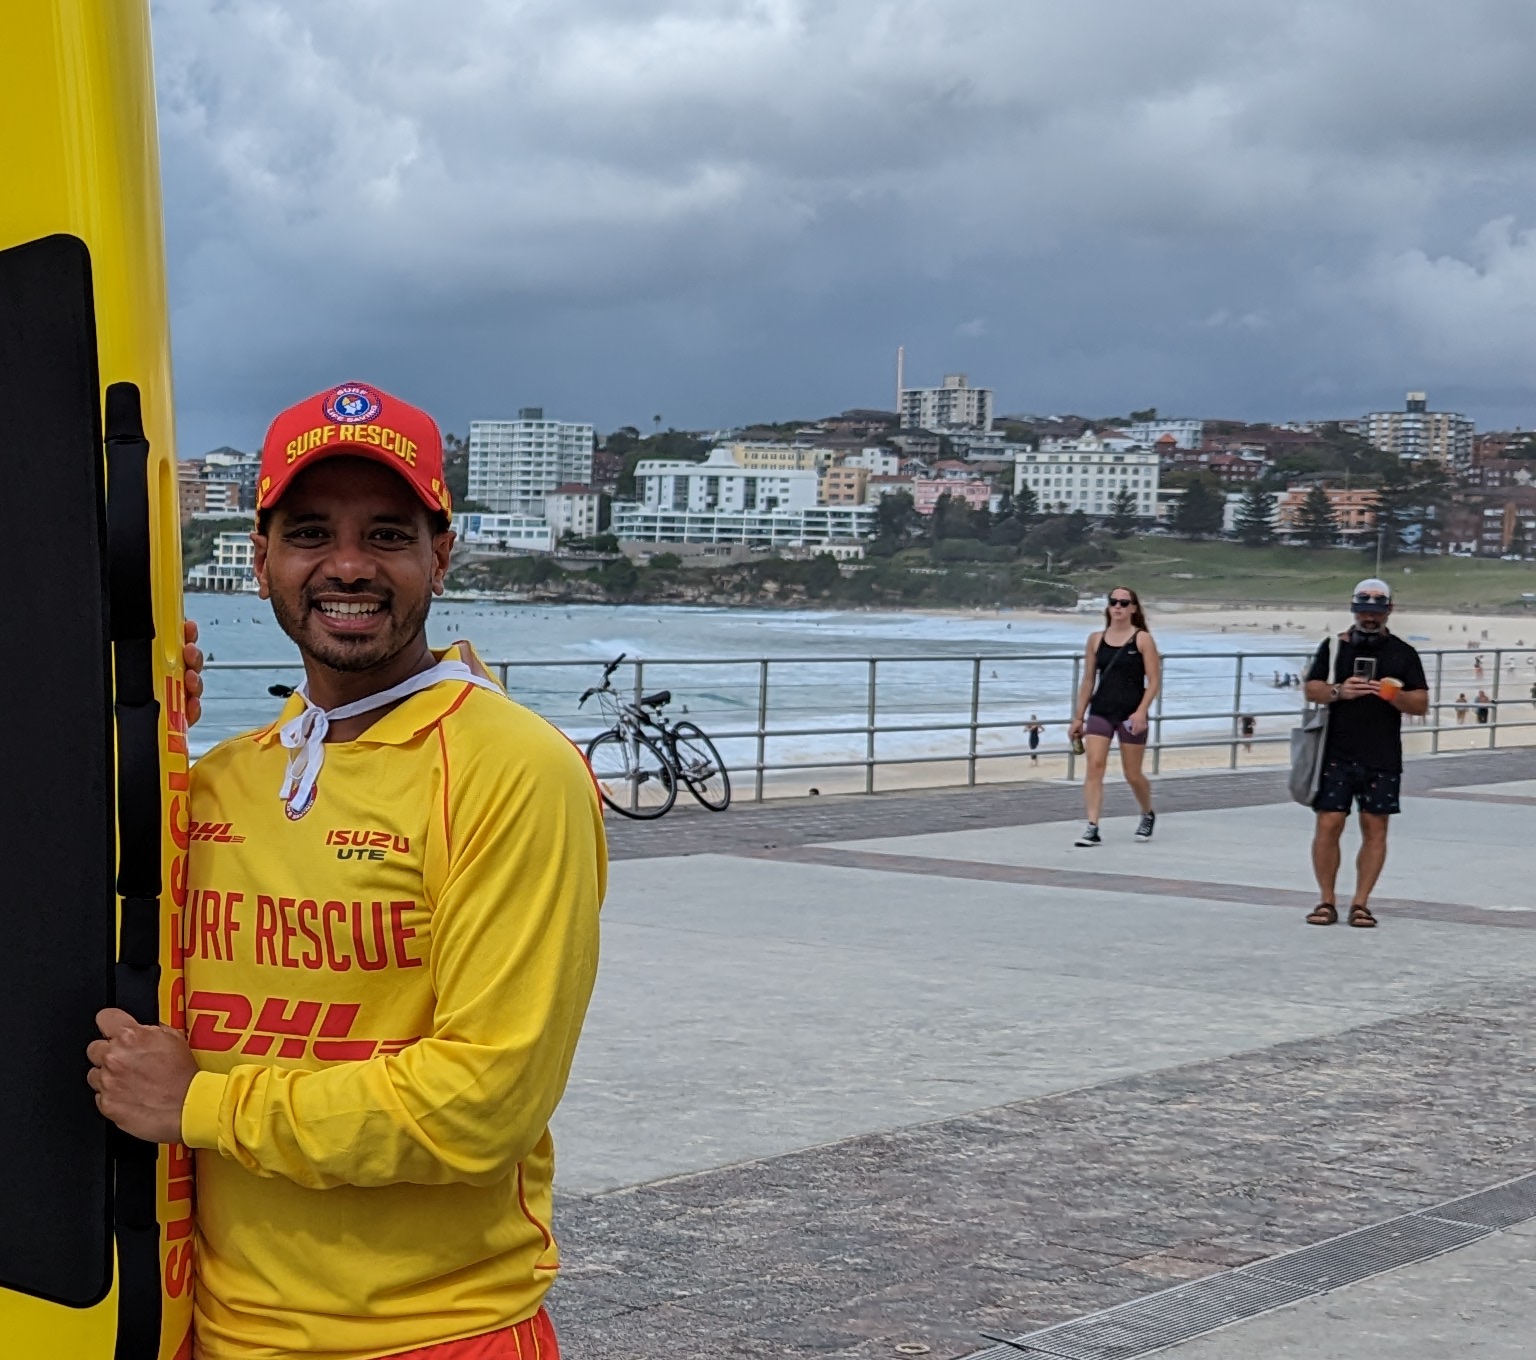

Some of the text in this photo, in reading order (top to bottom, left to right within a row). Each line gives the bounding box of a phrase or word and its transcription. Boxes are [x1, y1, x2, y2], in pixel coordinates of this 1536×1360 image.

[337, 387, 368, 396] SURF
[286, 424, 418, 468] SURF RESCUE
[326, 830, 410, 854] ISUZU
[337, 848, 388, 860] UTE
[184, 889, 423, 972] URF RESCUE
[187, 990, 378, 1061] DHL
